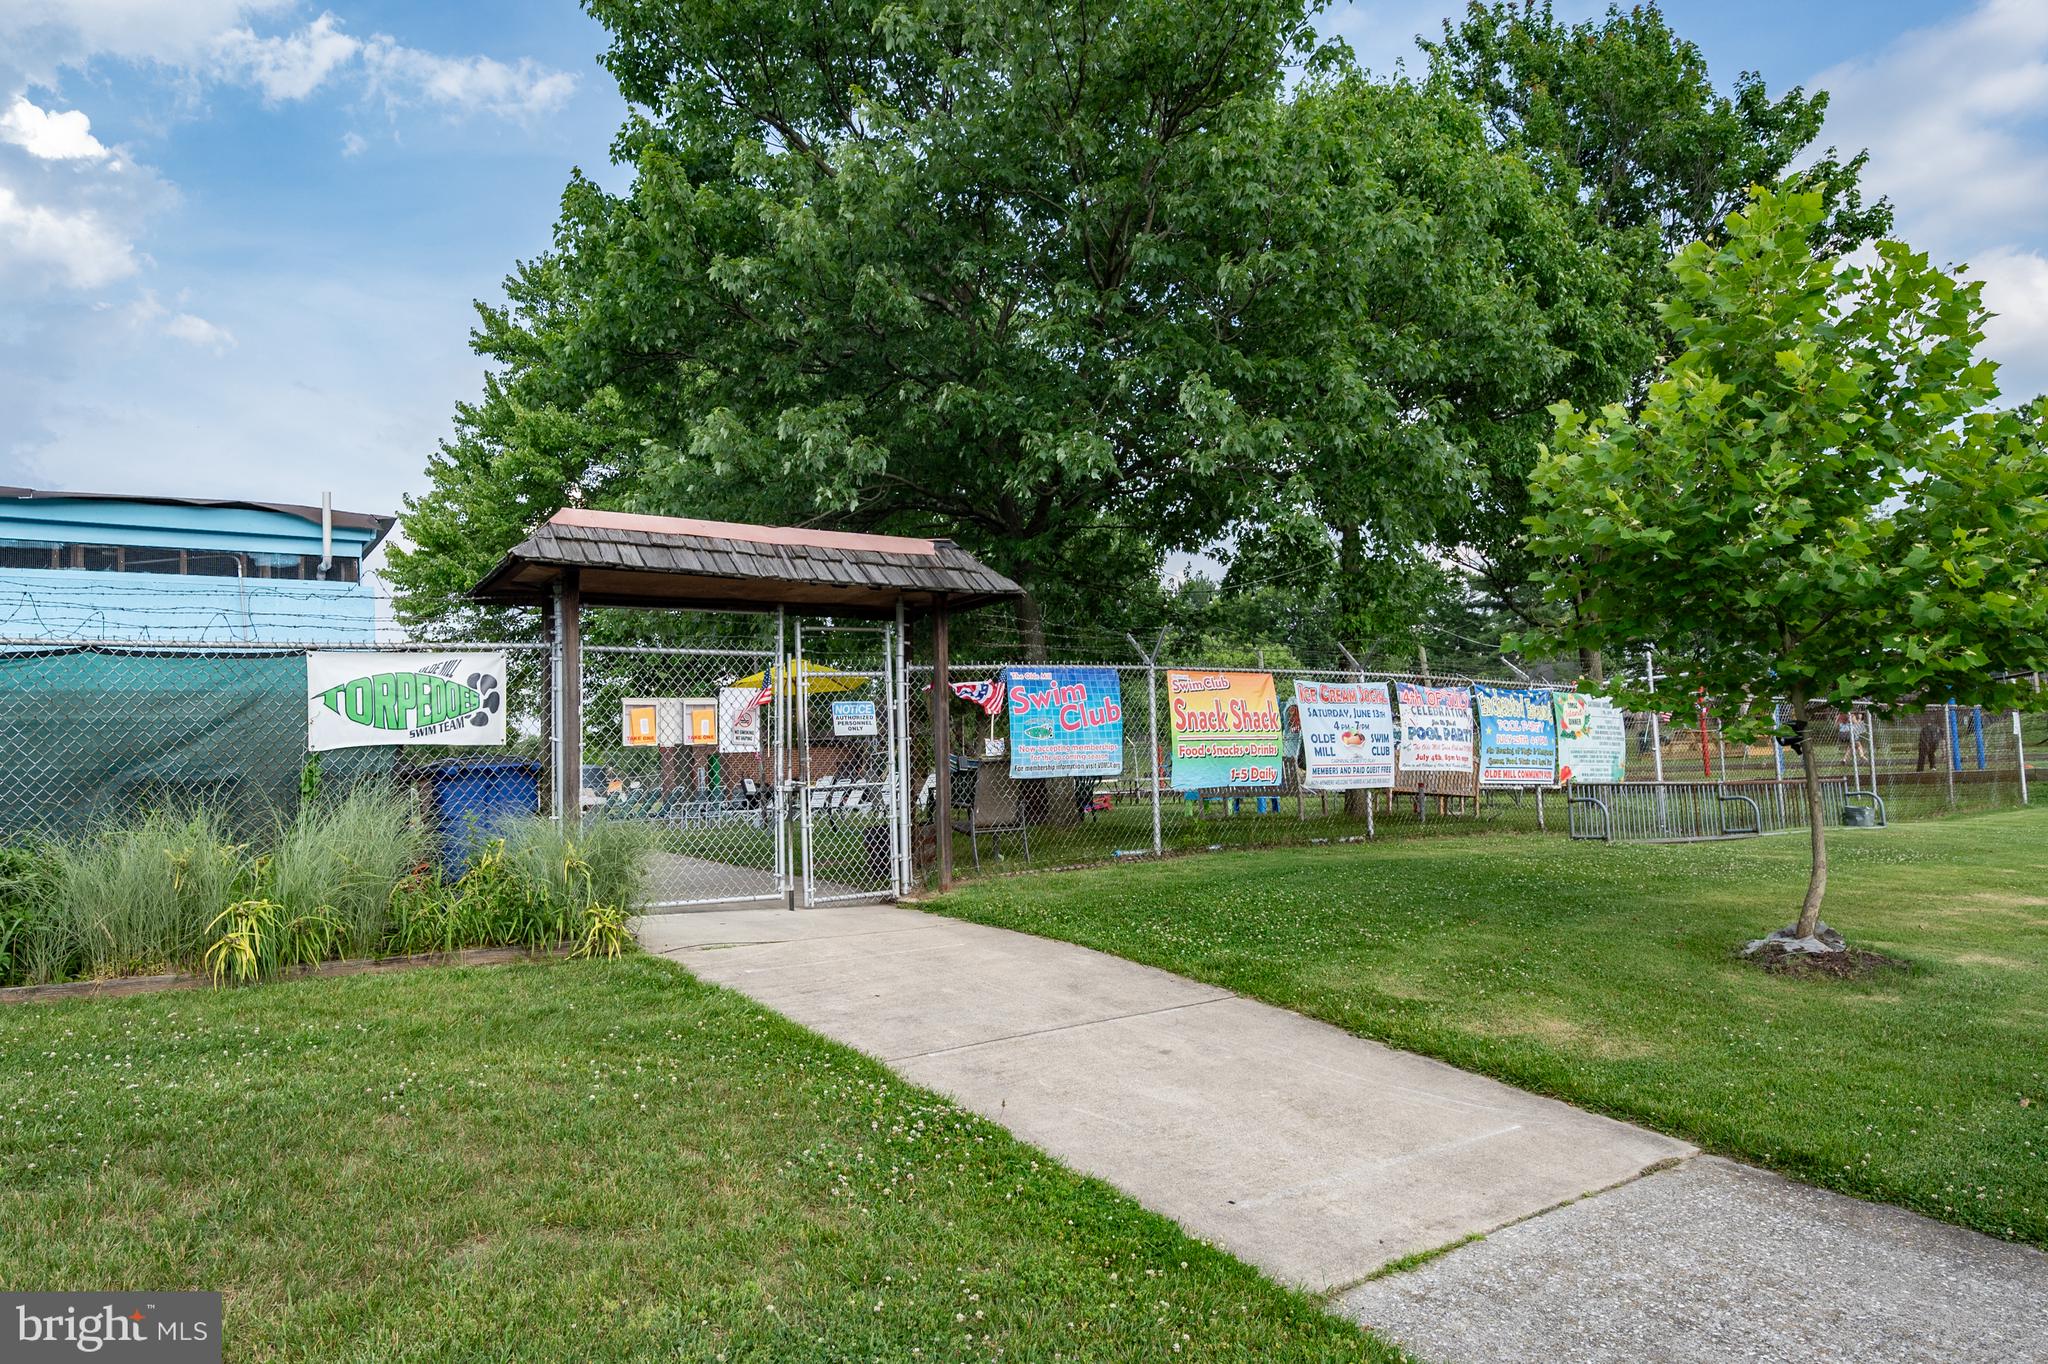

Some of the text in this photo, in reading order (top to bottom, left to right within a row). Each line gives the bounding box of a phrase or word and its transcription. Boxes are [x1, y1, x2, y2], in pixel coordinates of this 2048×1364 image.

[1173, 679, 1204, 692] Swim
[1204, 676, 1230, 690] Club
[1010, 680, 1087, 715] Swim
[1297, 683, 1318, 703] ICE
[1320, 684, 1357, 704] CREAM
[1403, 689, 1423, 706] 4th
[1426, 690, 1441, 708] OF
[312, 672, 480, 730] TORPEDOES
[835, 704, 871, 714] NOTICE
[1060, 696, 1122, 732] Club
[1174, 698, 1280, 732] Snack Shack
[1308, 708, 1352, 719] SATURDAY,
[1354, 708, 1371, 718] JUNE
[409, 716, 464, 738] SWIM TEAM
[1334, 721, 1340, 730] 4
[1354, 721, 1360, 730] 7
[1311, 734, 1336, 743] OLDE
[1371, 733, 1389, 743] SWIM
[1408, 726, 1472, 742] POOL PARTY
[1038, 745, 1070, 753] accepting
[1072, 744, 1118, 752] memberships
[1179, 744, 1277, 757] Food Snacks Drinks
[1314, 747, 1336, 757] MILL
[1372, 746, 1390, 756] CLUB
[1025, 764, 1056, 772] membership
[1312, 766, 1338, 774] MEMBERS
[1340, 766, 1351, 774] AND
[1353, 766, 1365, 774] PAID
[1484, 770, 1501, 778] OLDE
[1503, 770, 1516, 778] MILL
[1231, 768, 1278, 783] 1-5 Daily
